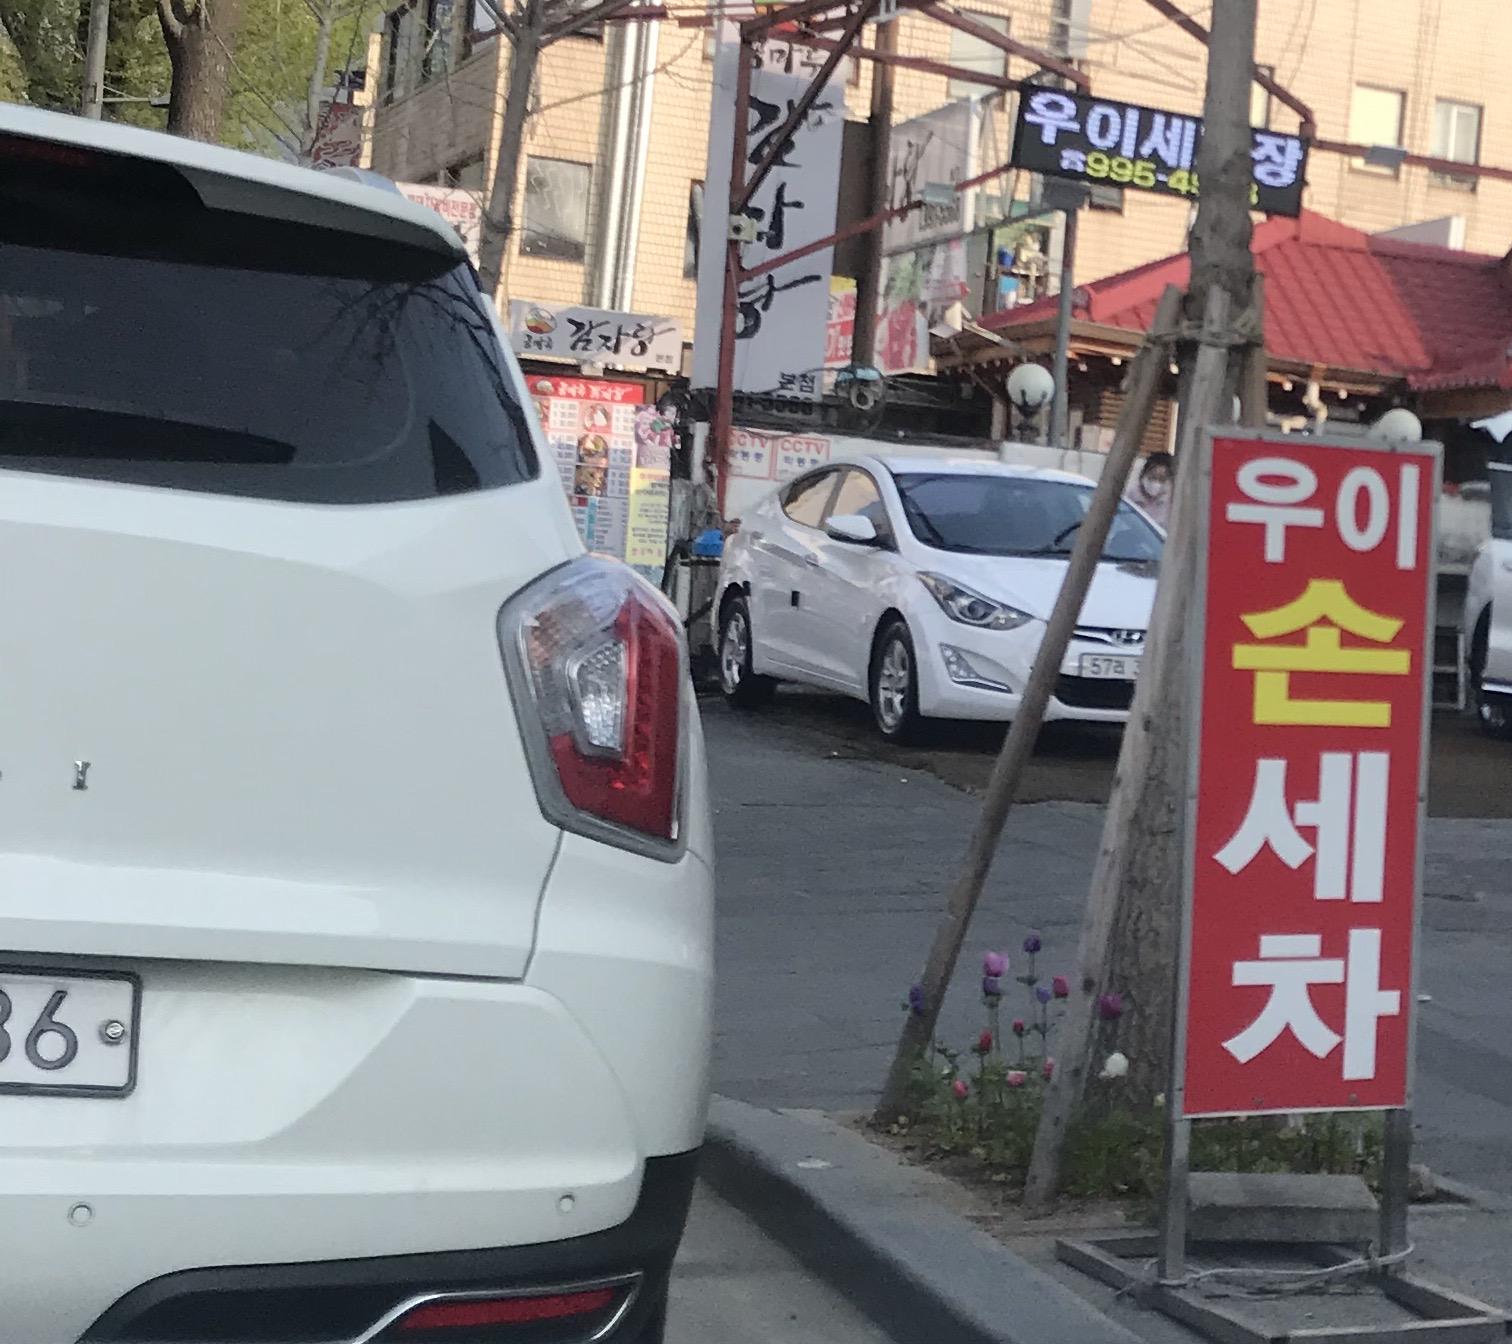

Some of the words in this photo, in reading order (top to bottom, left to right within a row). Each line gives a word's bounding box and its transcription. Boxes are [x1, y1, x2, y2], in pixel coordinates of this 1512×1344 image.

[1024, 91, 1304, 188] 우이세장
[1086, 151, 1259, 206] 995-4
[780, 439, 825, 455] CCTV
[1226, 456, 1420, 571] 우이
